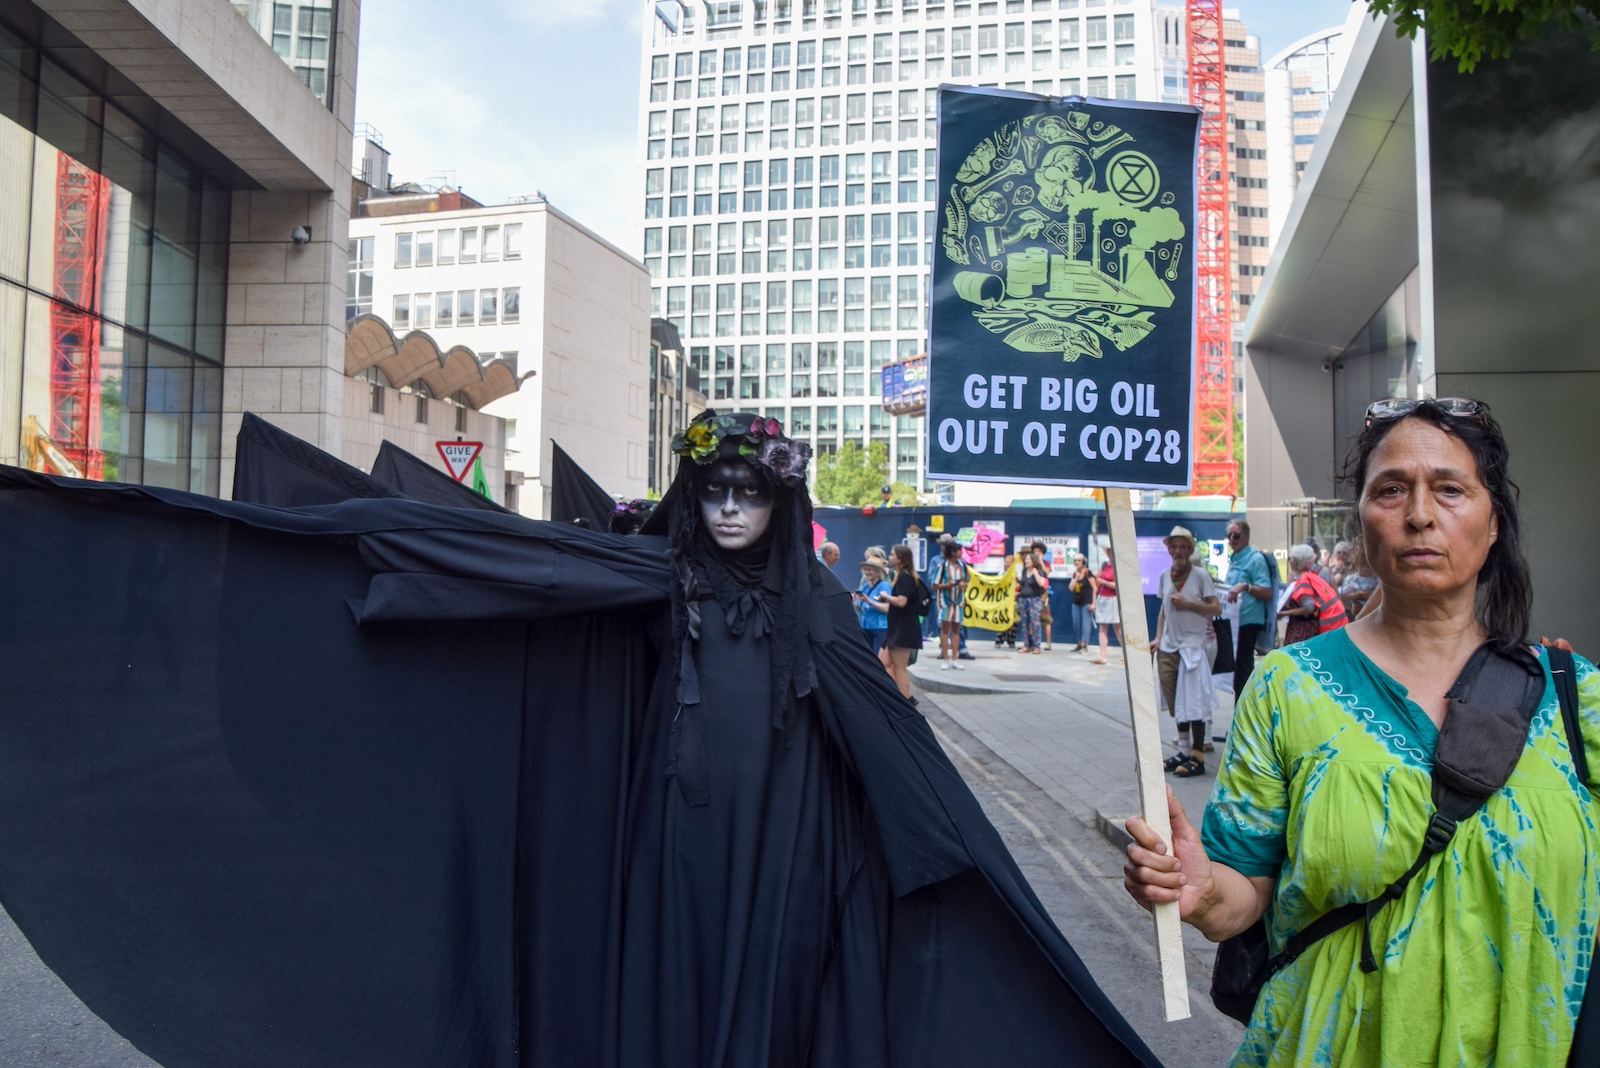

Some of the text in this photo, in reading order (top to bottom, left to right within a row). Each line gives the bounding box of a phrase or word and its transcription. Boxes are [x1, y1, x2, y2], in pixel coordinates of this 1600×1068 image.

[964, 373, 1159, 417] GET BIG OIL
[446, 446, 471, 455] GIVE
[938, 418, 1181, 464] OUT OF COP28
